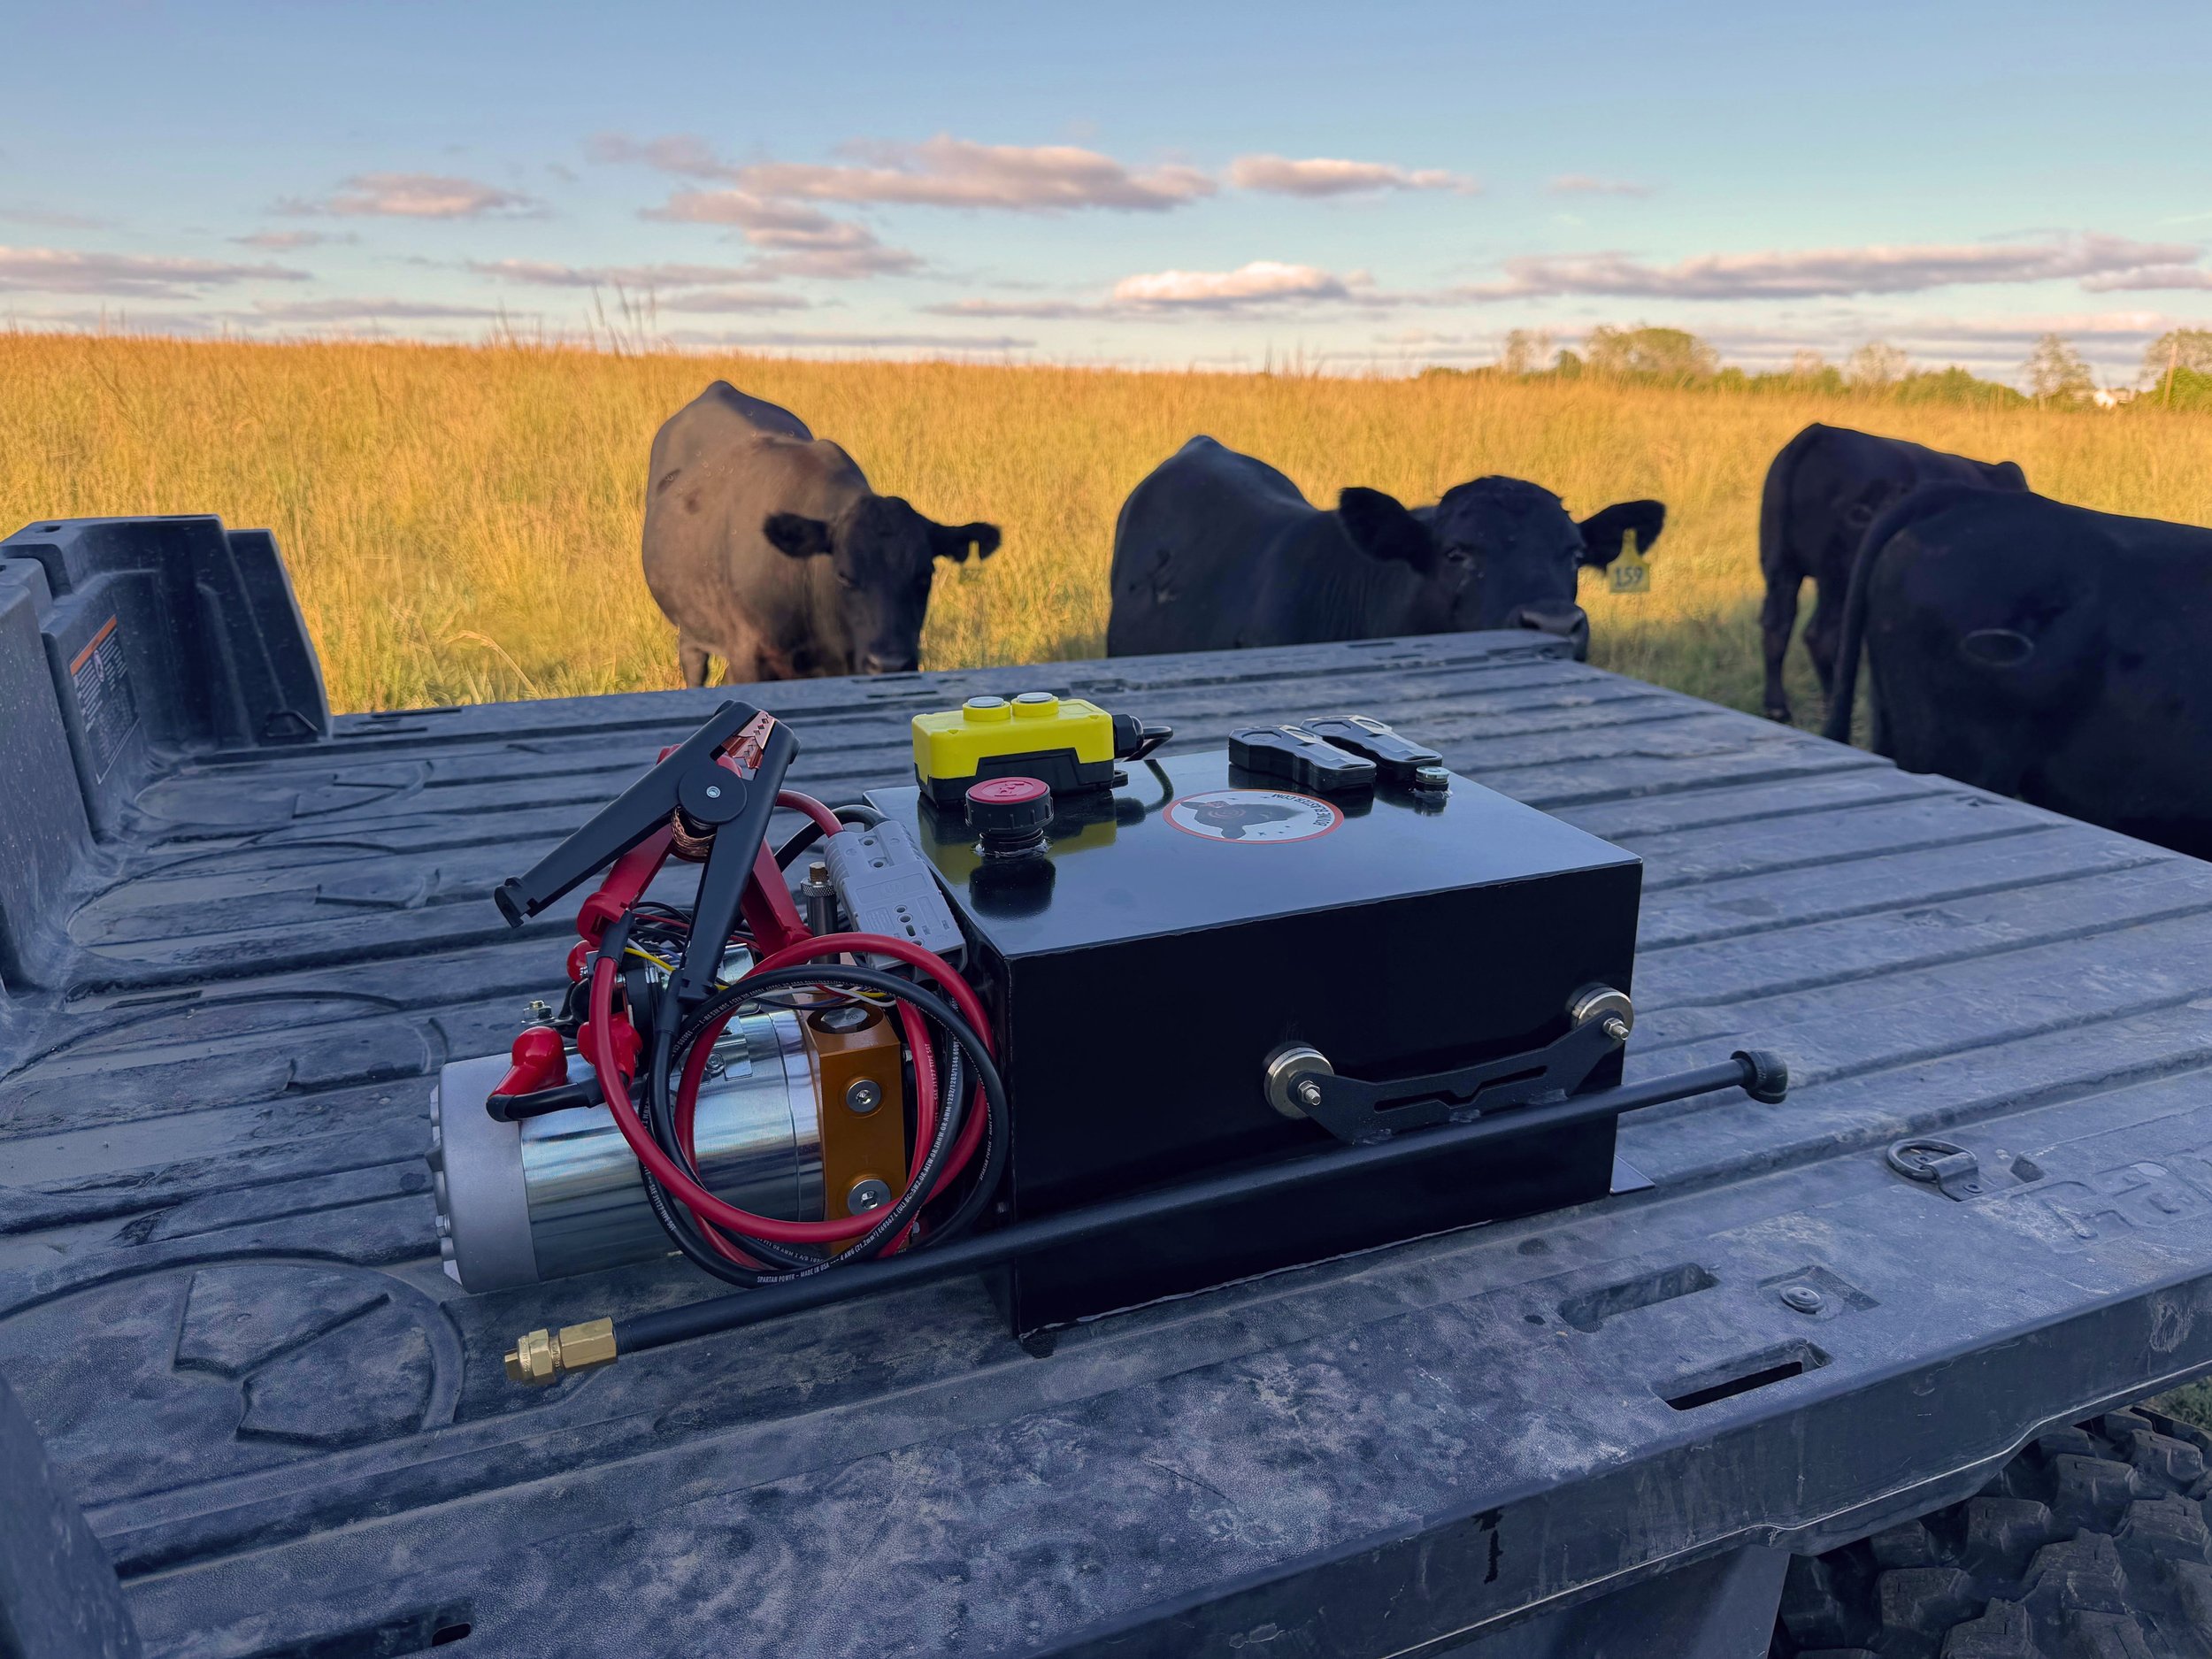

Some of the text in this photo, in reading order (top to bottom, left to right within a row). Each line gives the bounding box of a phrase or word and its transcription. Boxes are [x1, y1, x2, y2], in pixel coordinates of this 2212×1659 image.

[1615, 566, 1643, 588] 159
[800, 1268, 813, 1278] MADE
[844, 1248, 855, 1259] AWG
[918, 1171, 926, 1181] OR
[923, 1157, 933, 1172] MTW
[930, 1148, 938, 1158] OR
[940, 1122, 948, 1132] OR
